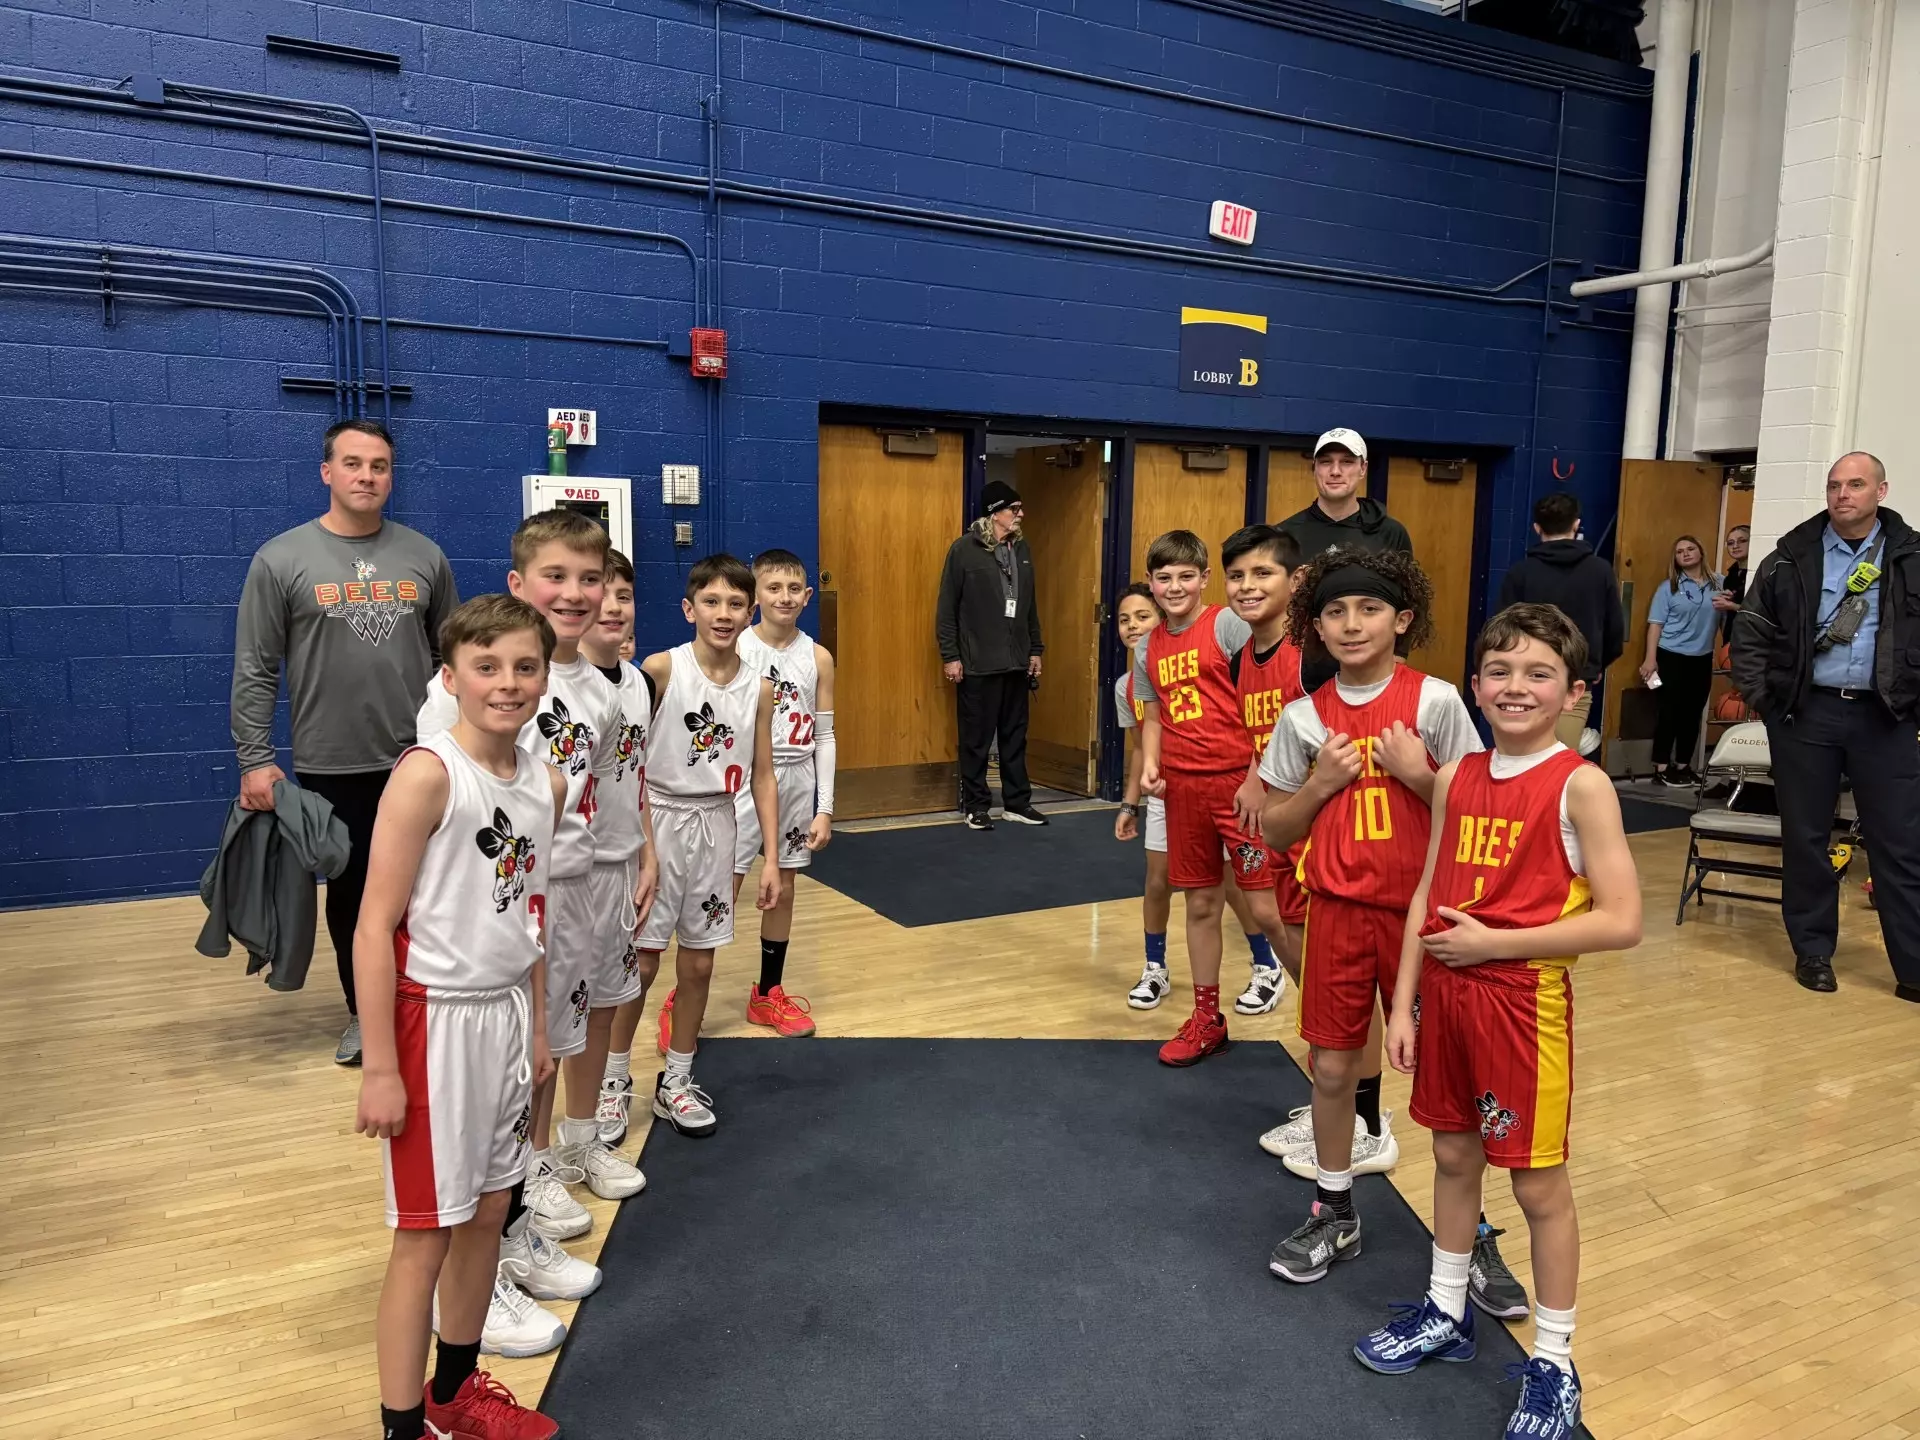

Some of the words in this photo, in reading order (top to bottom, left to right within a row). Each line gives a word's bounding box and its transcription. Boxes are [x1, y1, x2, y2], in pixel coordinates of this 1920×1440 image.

[1221, 204, 1252, 240] EXIT
[1193, 370, 1233, 385] LOBBY
[1238, 358, 1259, 386] B
[557, 412, 576, 421] AED
[580, 412, 590, 422] AED
[576, 489, 600, 500] AED
[315, 581, 418, 605] BEES
[325, 600, 414, 614] BASKETBALL
[1158, 648, 1199, 687] BEES
[1169, 685, 1203, 724] 23
[1245, 688, 1283, 728] BEES
[789, 712, 816, 746] 22
[1730, 737, 1768, 746] GOLDEN
[1354, 787, 1393, 841] 10
[1455, 815, 1525, 868] BEES
